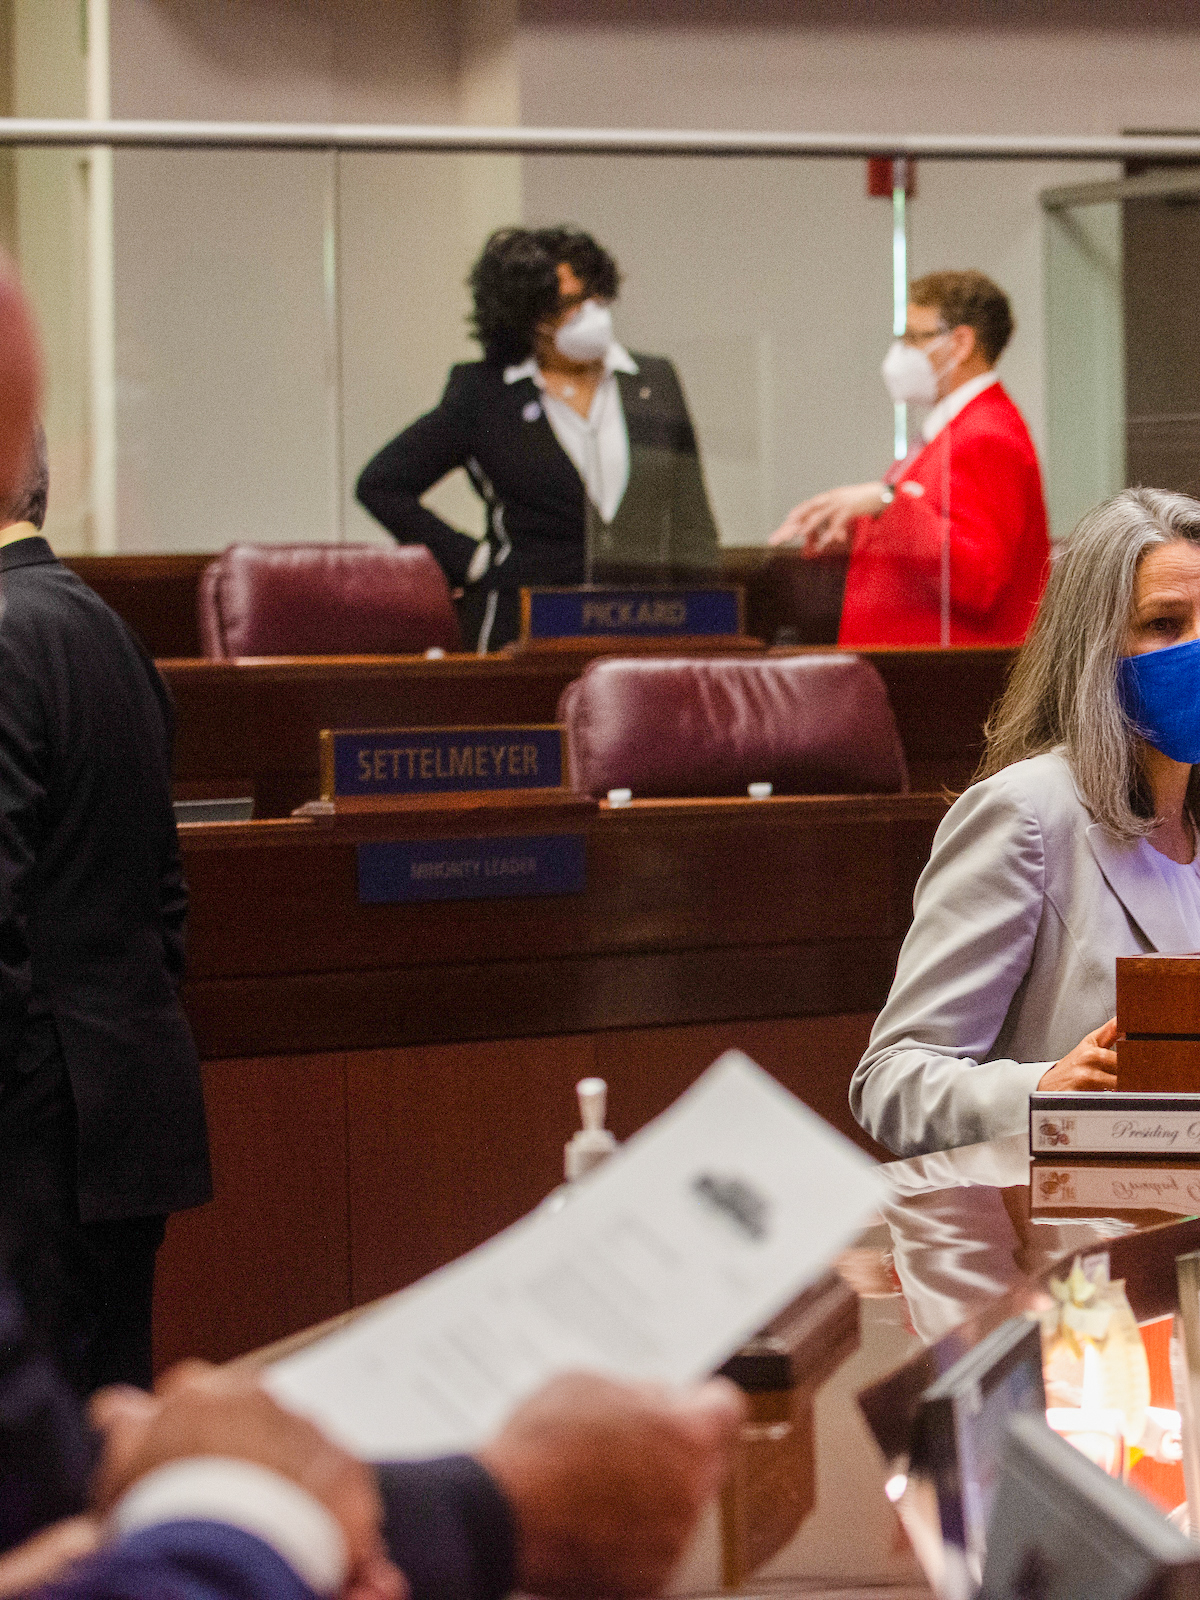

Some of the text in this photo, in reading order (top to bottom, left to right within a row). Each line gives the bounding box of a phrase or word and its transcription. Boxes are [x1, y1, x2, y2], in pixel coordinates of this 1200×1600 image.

[582, 600, 687, 628] PICKARD
[358, 744, 539, 782] SETTELMEYER
[1111, 1120, 1179, 1145] Presiding
